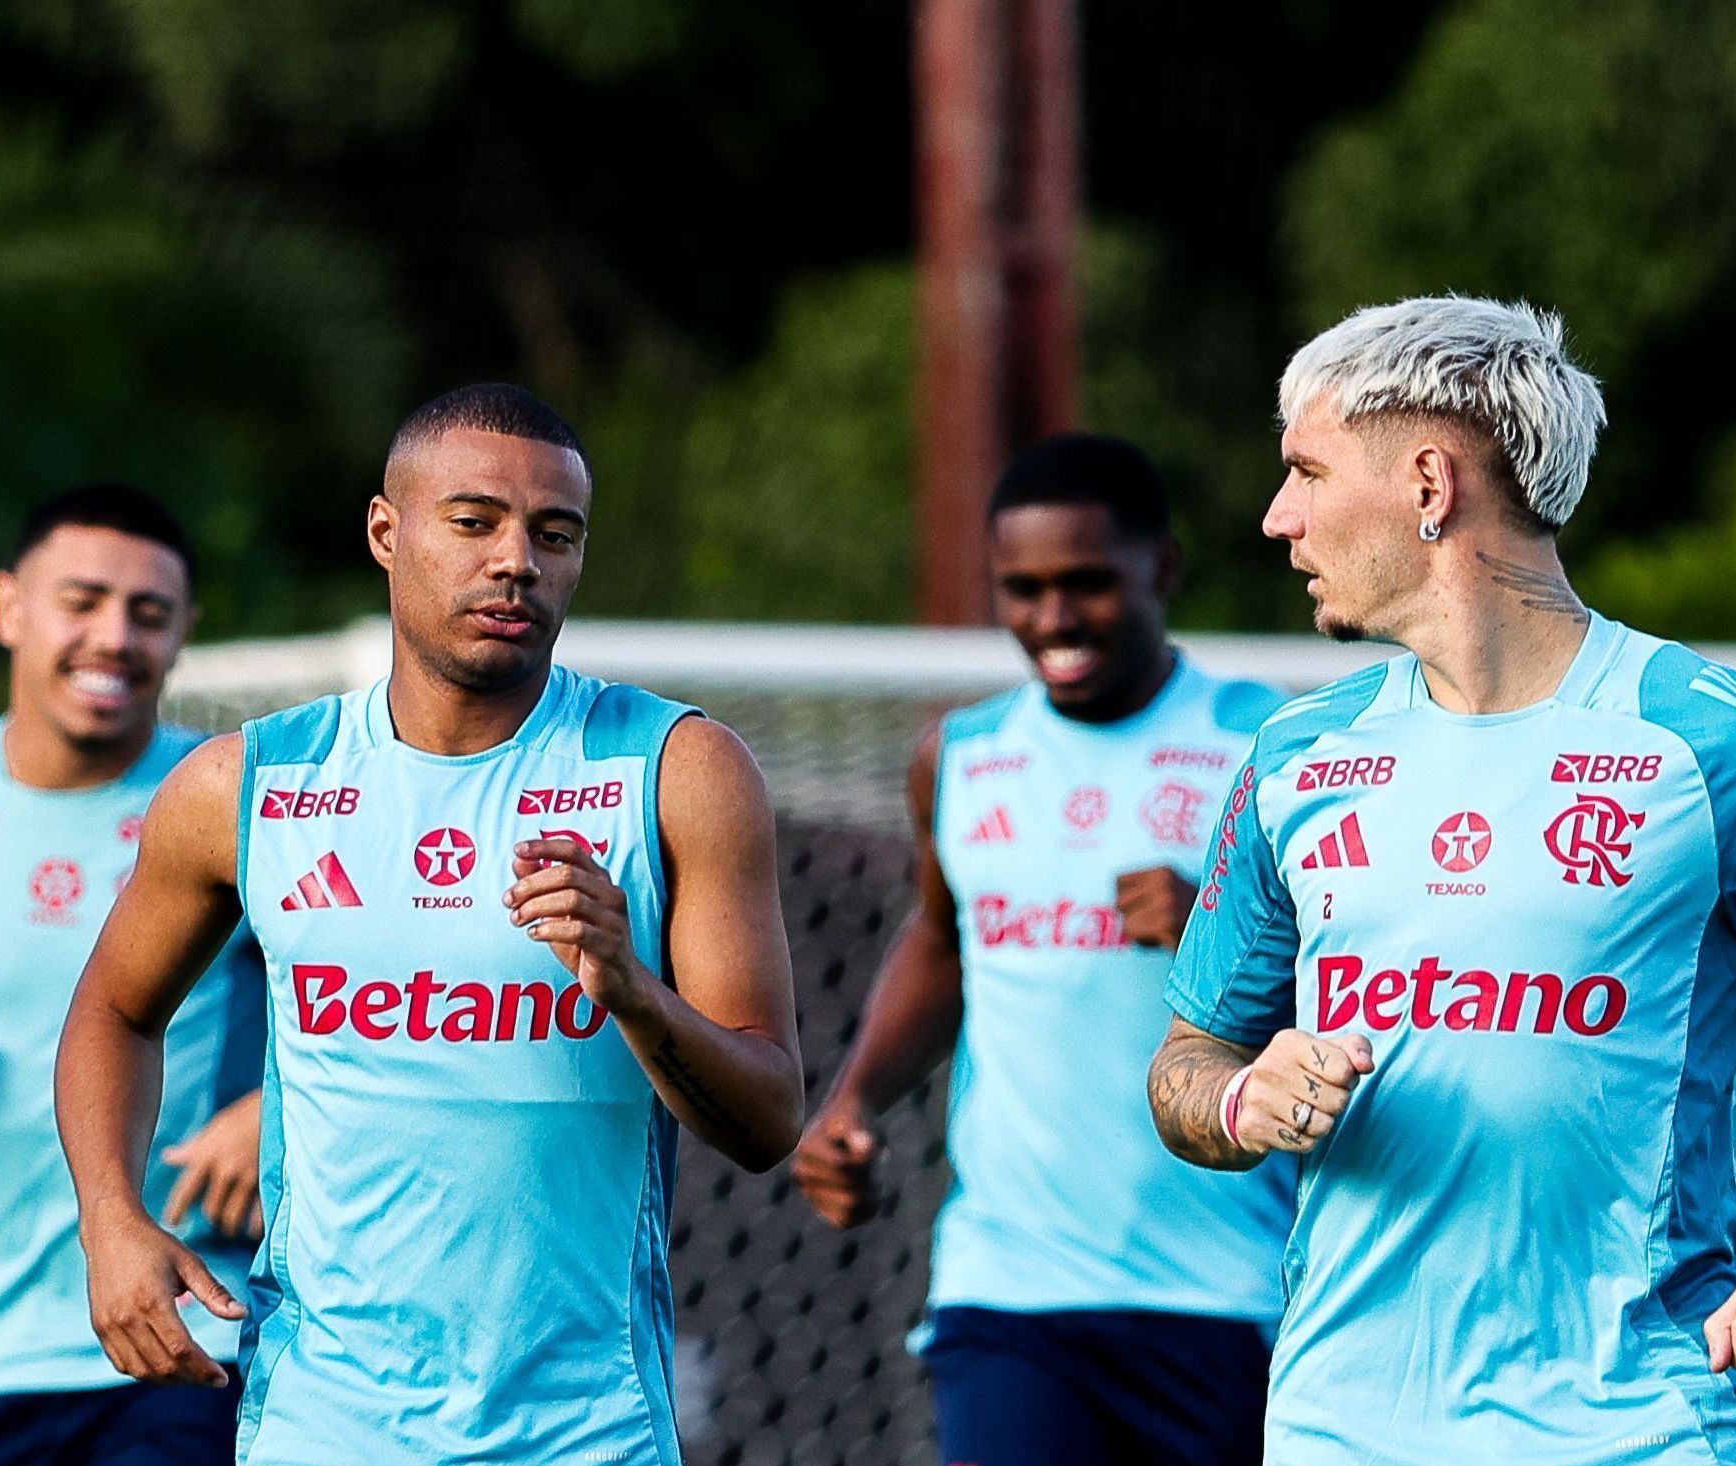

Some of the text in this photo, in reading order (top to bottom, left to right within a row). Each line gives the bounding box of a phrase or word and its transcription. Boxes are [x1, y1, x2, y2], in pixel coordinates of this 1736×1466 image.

[1327, 755, 1396, 787] BRB
[1588, 754, 1663, 783] BRB
[292, 786, 361, 819] BRB
[558, 781, 624, 814] BRB
[411, 895, 473, 909] TEXACO
[1425, 882, 1487, 896] TEXACO
[1323, 892, 1333, 920] 2
[292, 964, 610, 1043] Betano
[1317, 954, 1628, 1037] Betano
